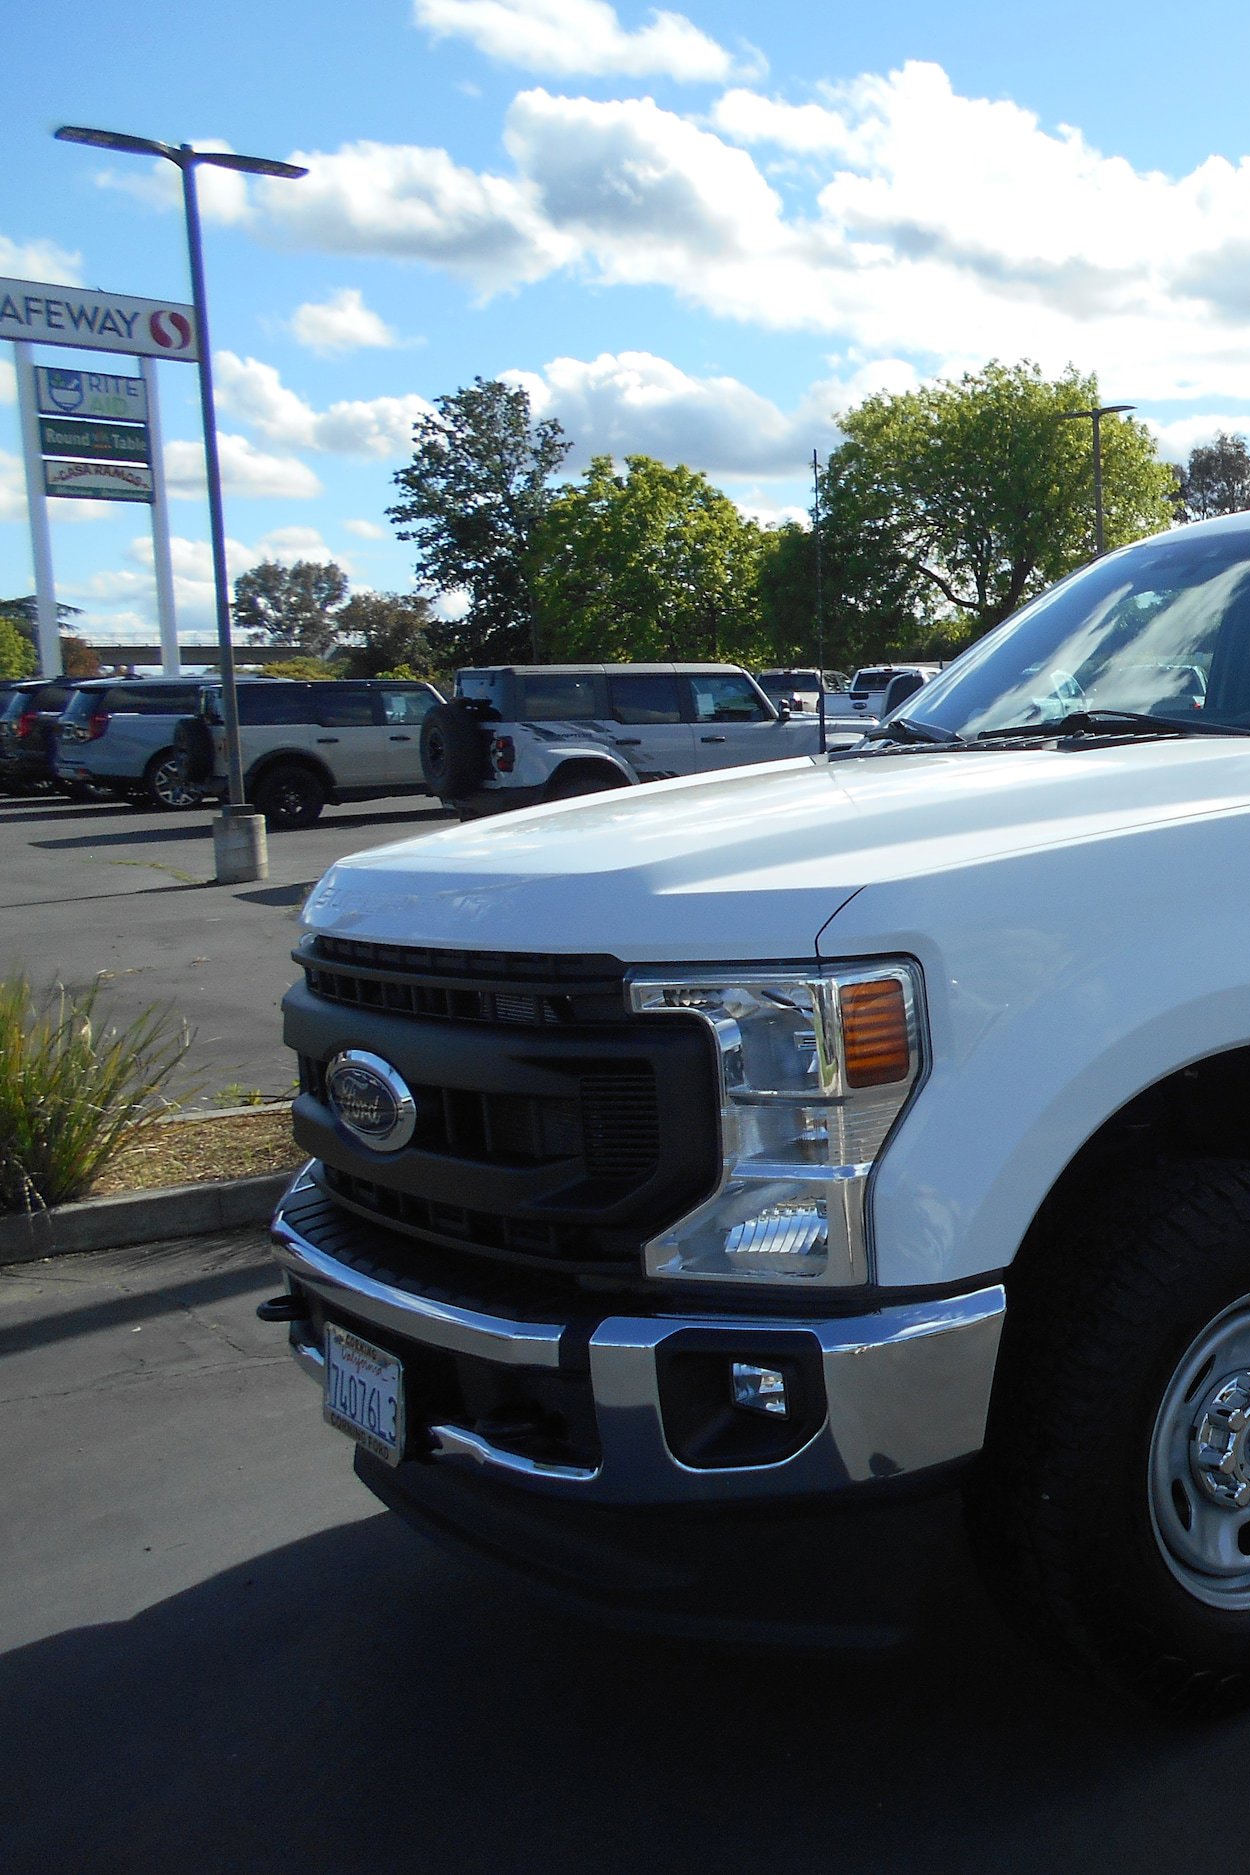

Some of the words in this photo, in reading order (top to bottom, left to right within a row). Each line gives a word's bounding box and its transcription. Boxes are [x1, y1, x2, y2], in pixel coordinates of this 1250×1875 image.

[0, 294, 140, 338] AFEWAY
[88, 374, 139, 397] RITE
[46, 427, 90, 447] Round
[111, 432, 147, 451] Table
[367, 1434, 389, 1460] FORD
